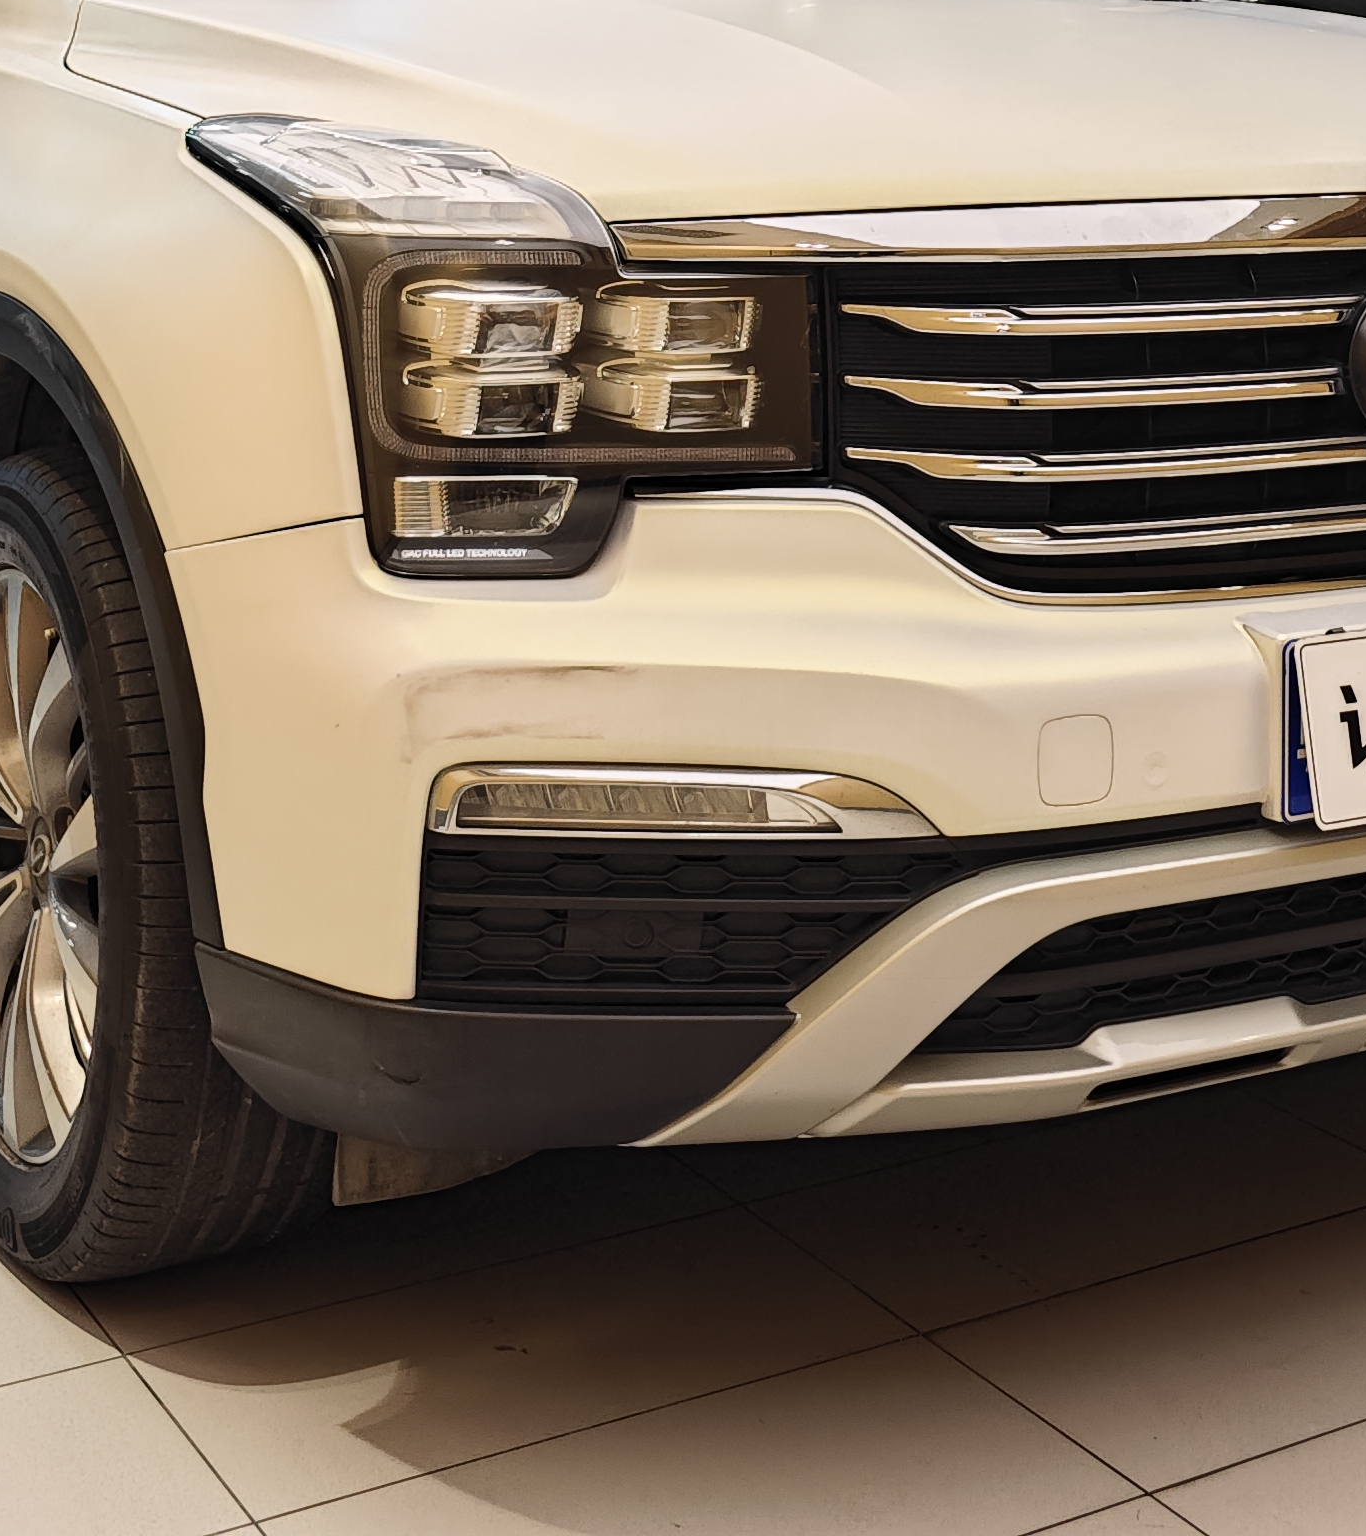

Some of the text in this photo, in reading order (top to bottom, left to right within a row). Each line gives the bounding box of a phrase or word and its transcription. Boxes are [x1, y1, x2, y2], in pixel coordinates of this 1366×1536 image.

[422, 549, 446, 558] FULL
[446, 549, 465, 558] LED
[466, 548, 528, 558] TECHNOLOGY
